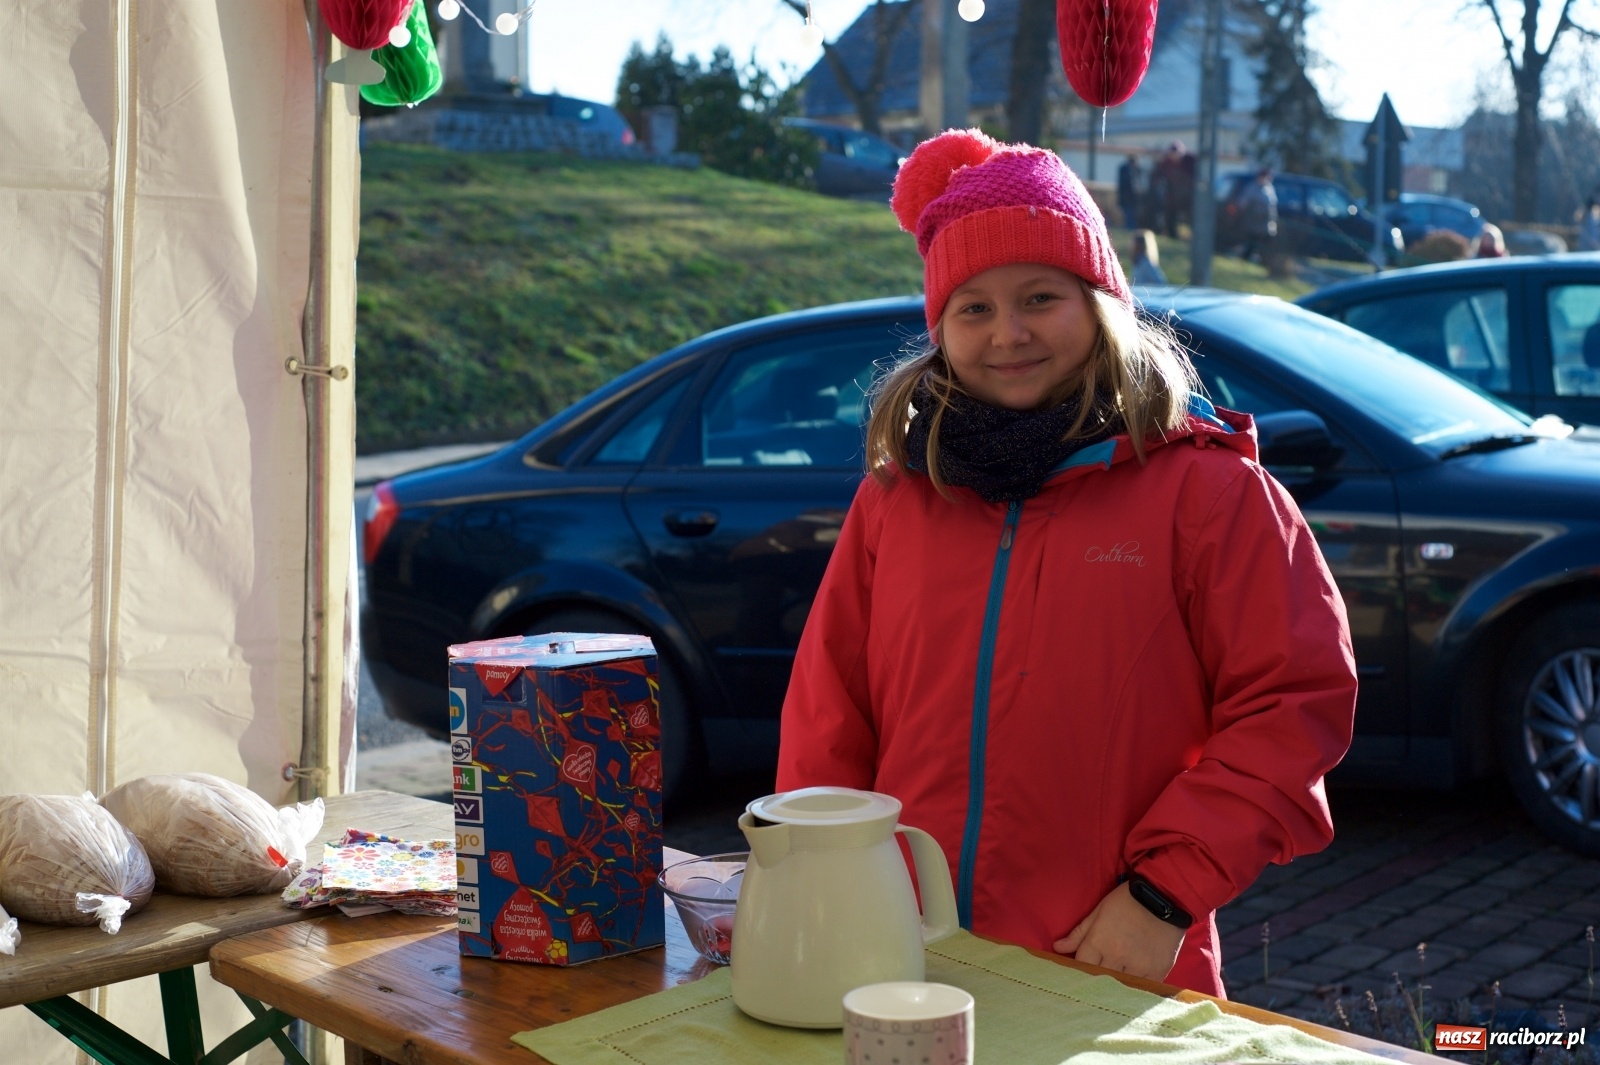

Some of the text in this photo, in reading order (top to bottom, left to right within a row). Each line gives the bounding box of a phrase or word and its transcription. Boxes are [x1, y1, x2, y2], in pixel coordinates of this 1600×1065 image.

[1085, 541, 1146, 567] Outhorn
[485, 669, 511, 683] pomocy
[509, 900, 534, 913] pomocy
